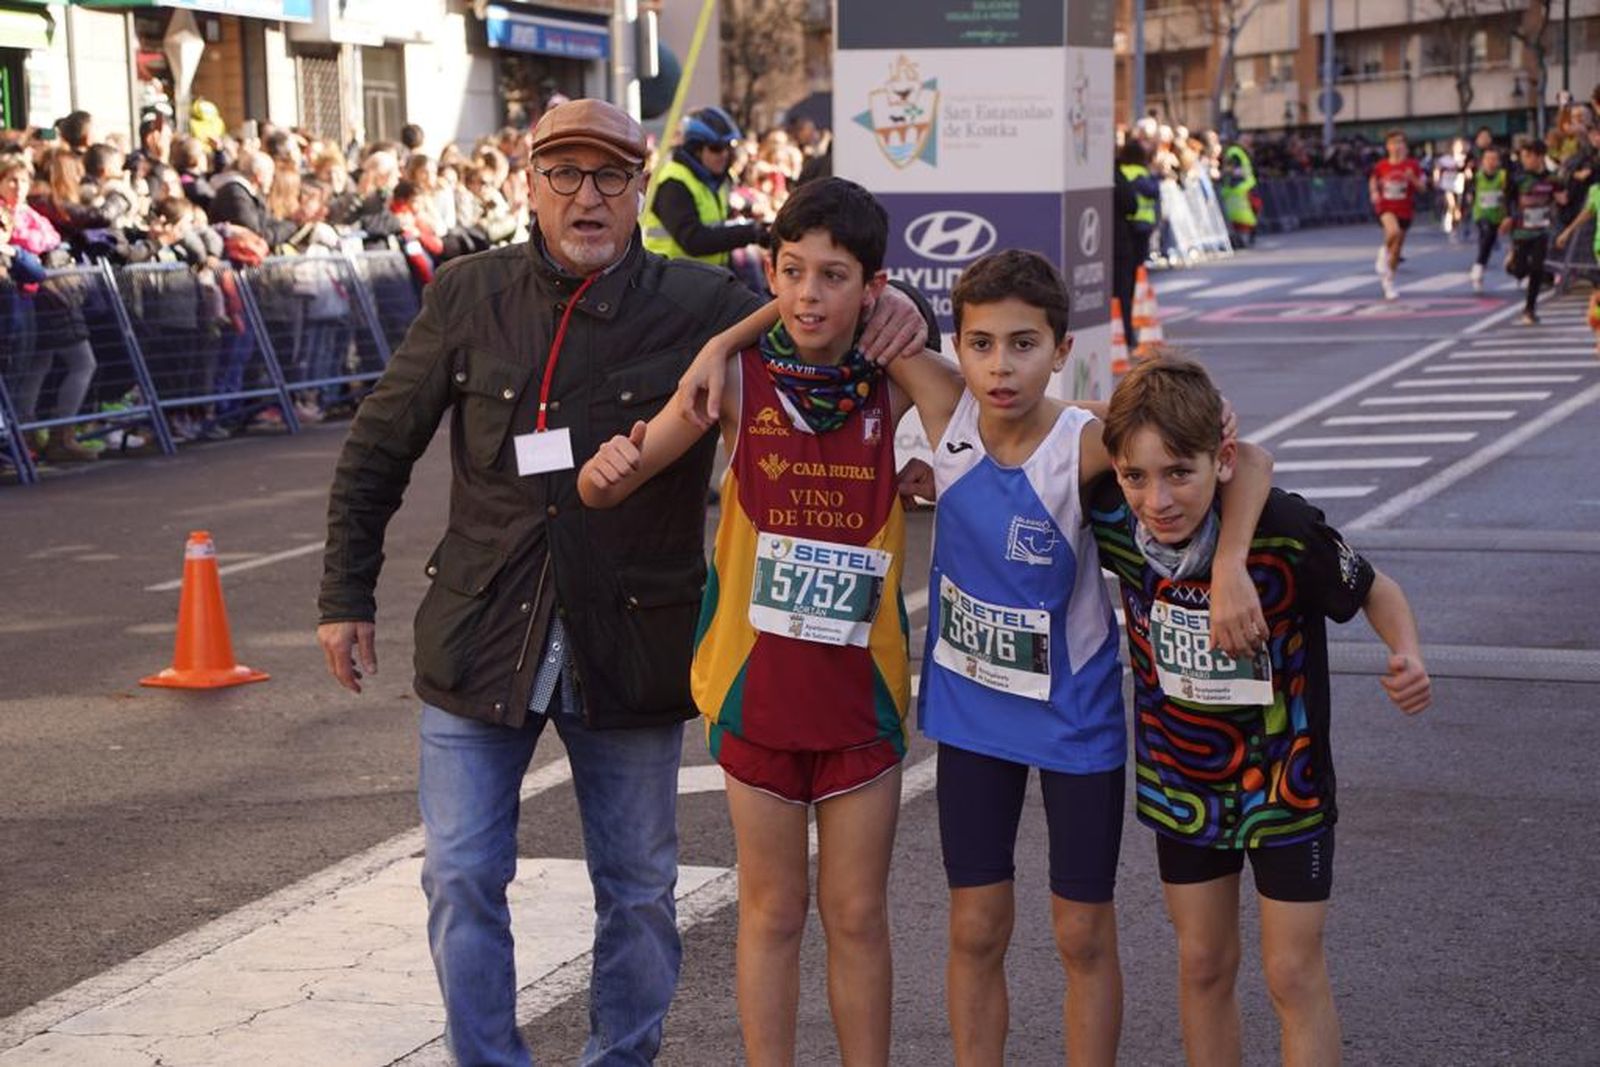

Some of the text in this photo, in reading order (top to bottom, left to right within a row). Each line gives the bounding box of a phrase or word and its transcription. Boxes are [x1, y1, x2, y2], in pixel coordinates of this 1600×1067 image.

[793, 462, 876, 480] CAJA RURAL
[790, 489, 844, 508] VINO
[769, 509, 864, 529] DE TORO
[794, 544, 876, 571] SETEL
[771, 561, 857, 613] 5752
[961, 596, 1035, 629] SETEL
[949, 607, 1017, 662] 5876
